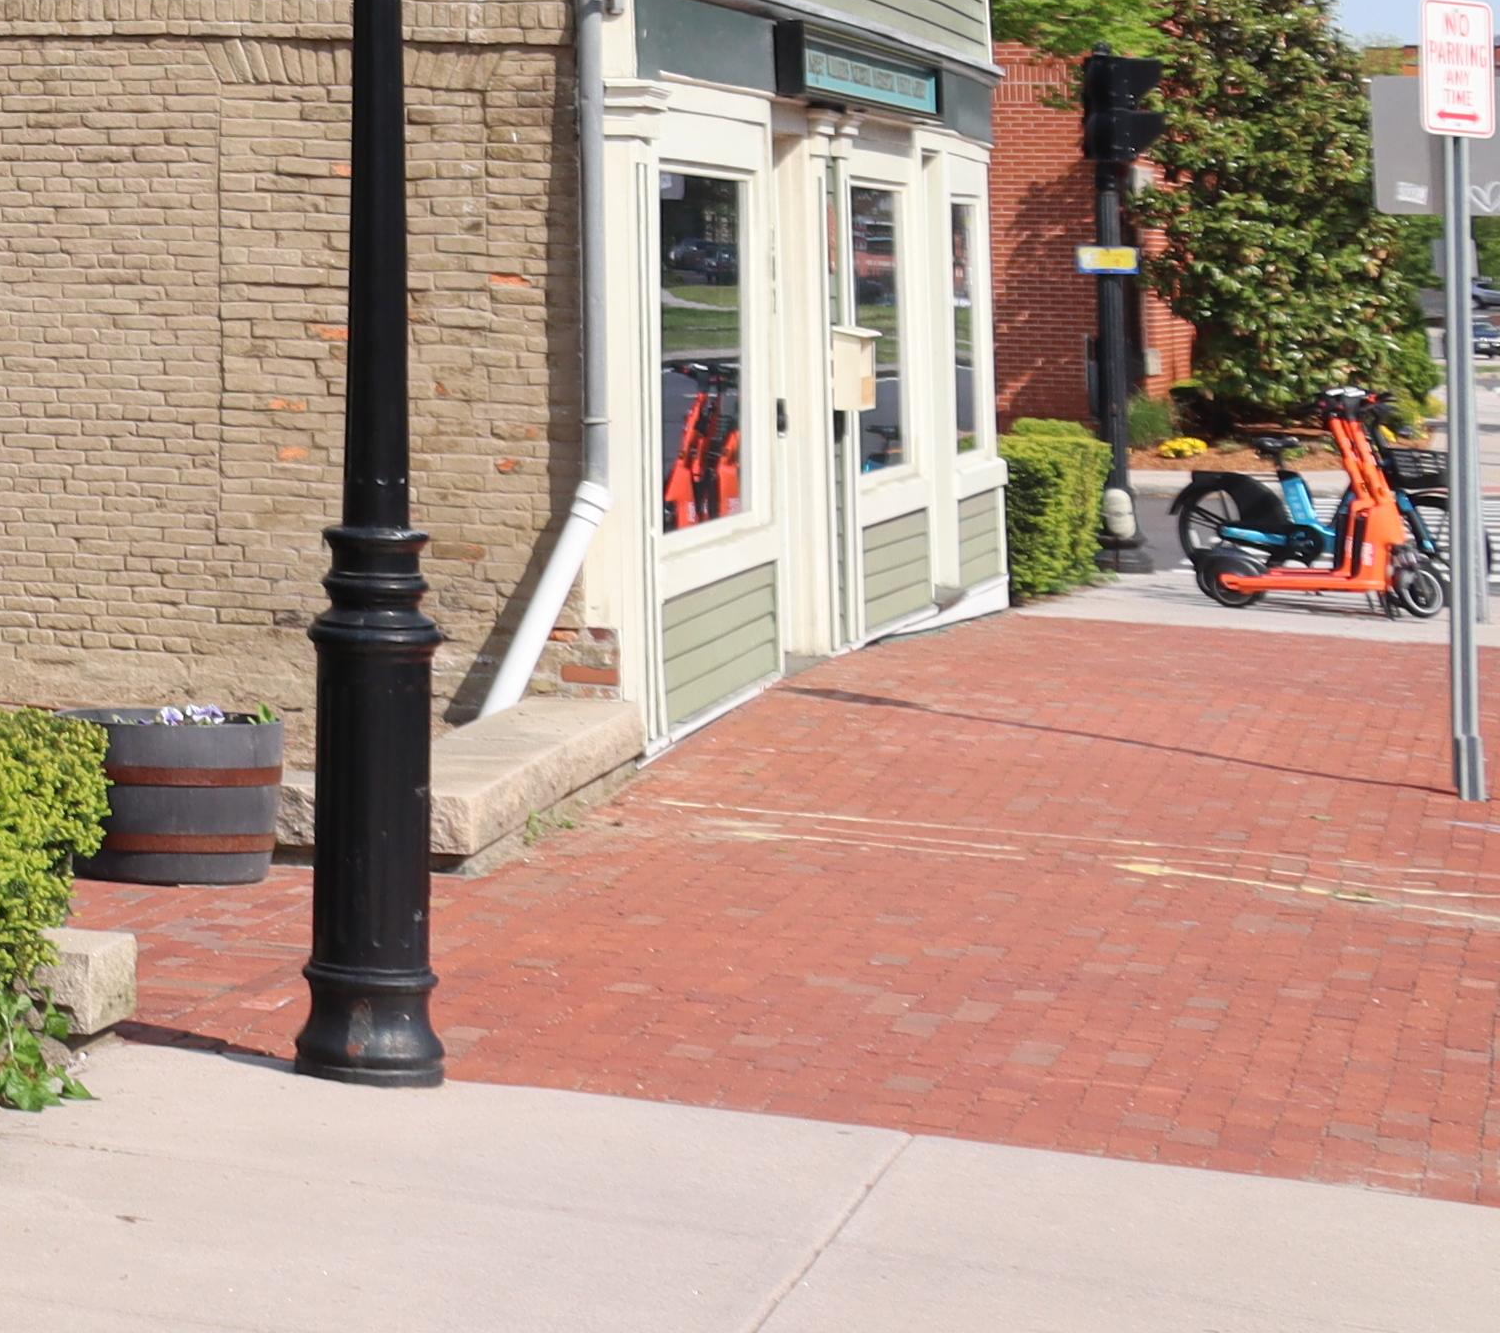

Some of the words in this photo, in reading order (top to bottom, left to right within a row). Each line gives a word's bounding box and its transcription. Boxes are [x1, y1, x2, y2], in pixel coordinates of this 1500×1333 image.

[1443, 13, 1470, 37] NO
[1428, 39, 1488, 69] PARKING
[1445, 69, 1471, 88] ANY
[1443, 88, 1473, 108] TIME
